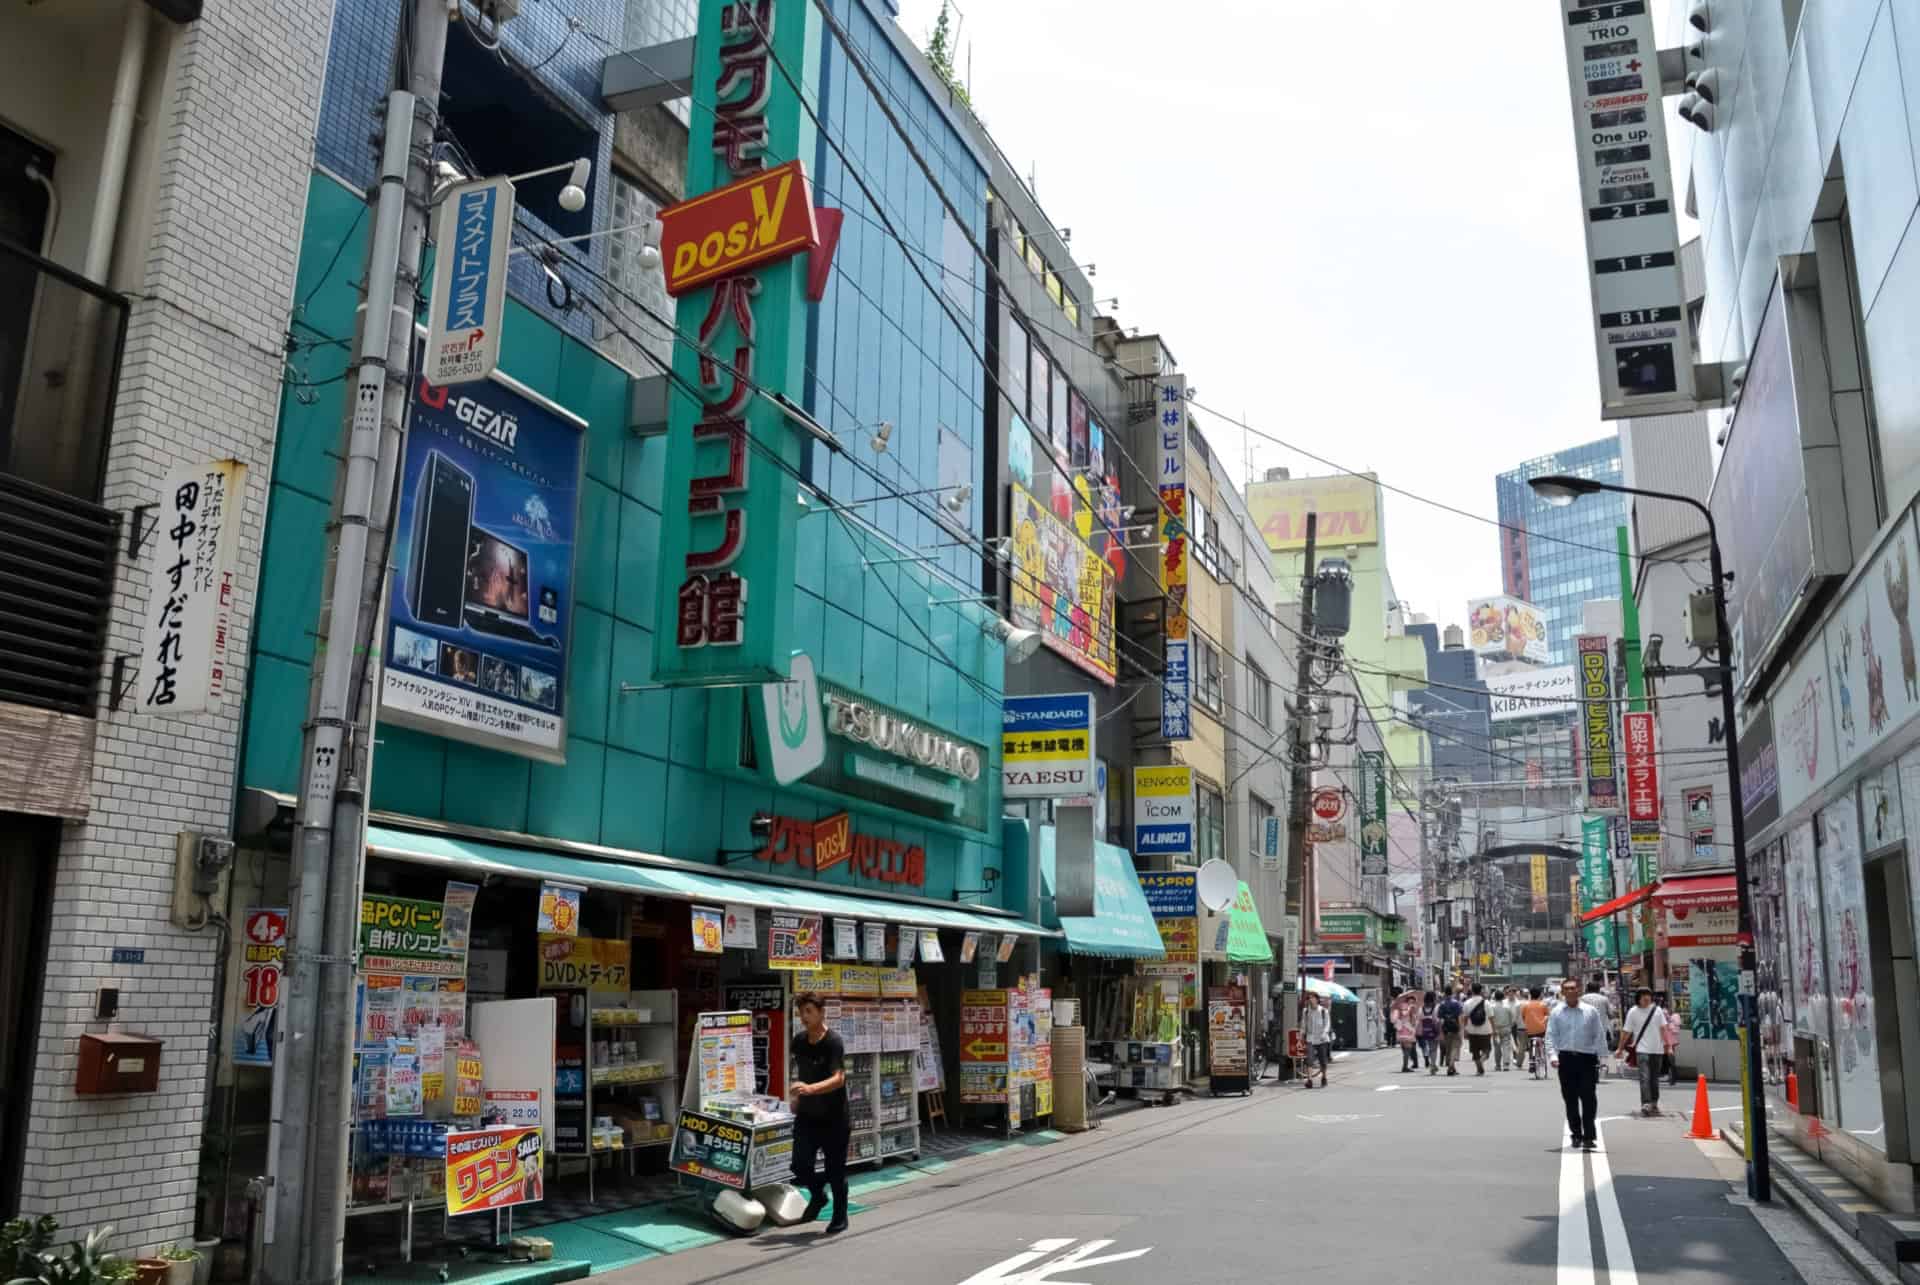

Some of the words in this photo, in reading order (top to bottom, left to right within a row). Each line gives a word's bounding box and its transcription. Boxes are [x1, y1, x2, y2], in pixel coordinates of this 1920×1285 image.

[1589, 25, 1630, 41] TRIO
[1592, 131, 1622, 145] One
[1620, 309, 1661, 325] B1F
[1161, 384, 1181, 475] 北林ビル
[146, 480, 200, 706] 田中すだれ店
[219, 570, 233, 607] TEL
[1015, 710, 1083, 721] STANDARD
[823, 692, 980, 782] TSUKUMO
[1004, 738, 1085, 754] 富士無線電機
[1629, 716, 1653, 816] 防犯カメラ・工事
[1006, 769, 1084, 785] YAESU
[1137, 776, 1189, 788] KENWOOD
[1141, 831, 1187, 845] ALINCO
[544, 962, 625, 985] DVDメディア
[517, 1135, 541, 1158] SALE!
[456, 1148, 518, 1204] ワゴン
